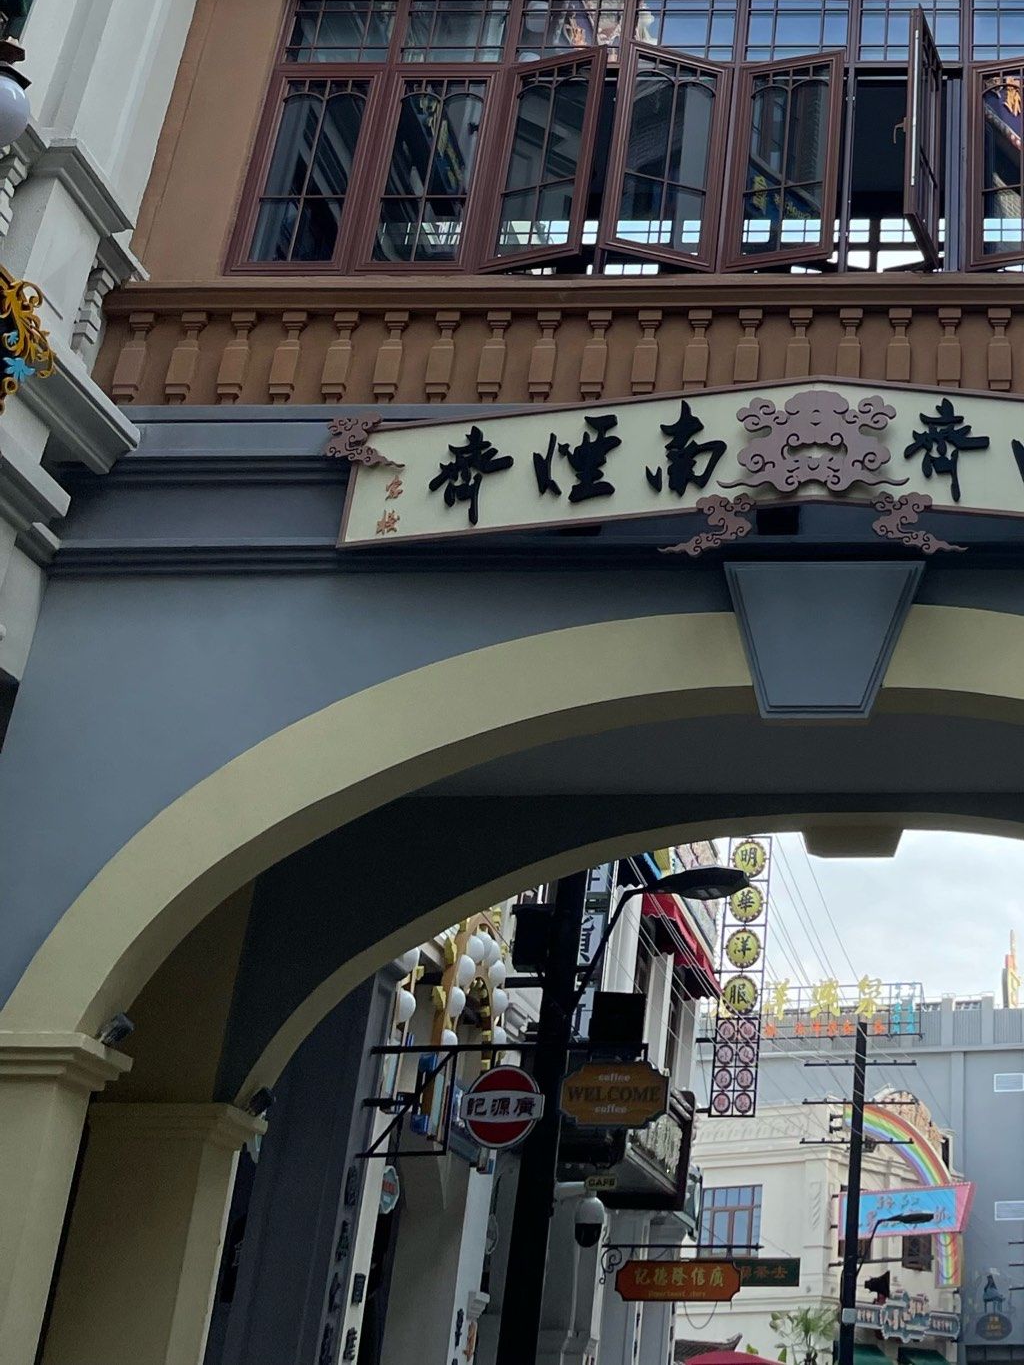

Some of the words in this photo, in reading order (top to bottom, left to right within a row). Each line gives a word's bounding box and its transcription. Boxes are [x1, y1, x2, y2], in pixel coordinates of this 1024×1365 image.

[727, 847, 759, 1005] 明華洋服
[598, 1072, 631, 1083] coffee
[566, 1085, 662, 1103] WELCOME
[594, 1104, 628, 1115] coffee
